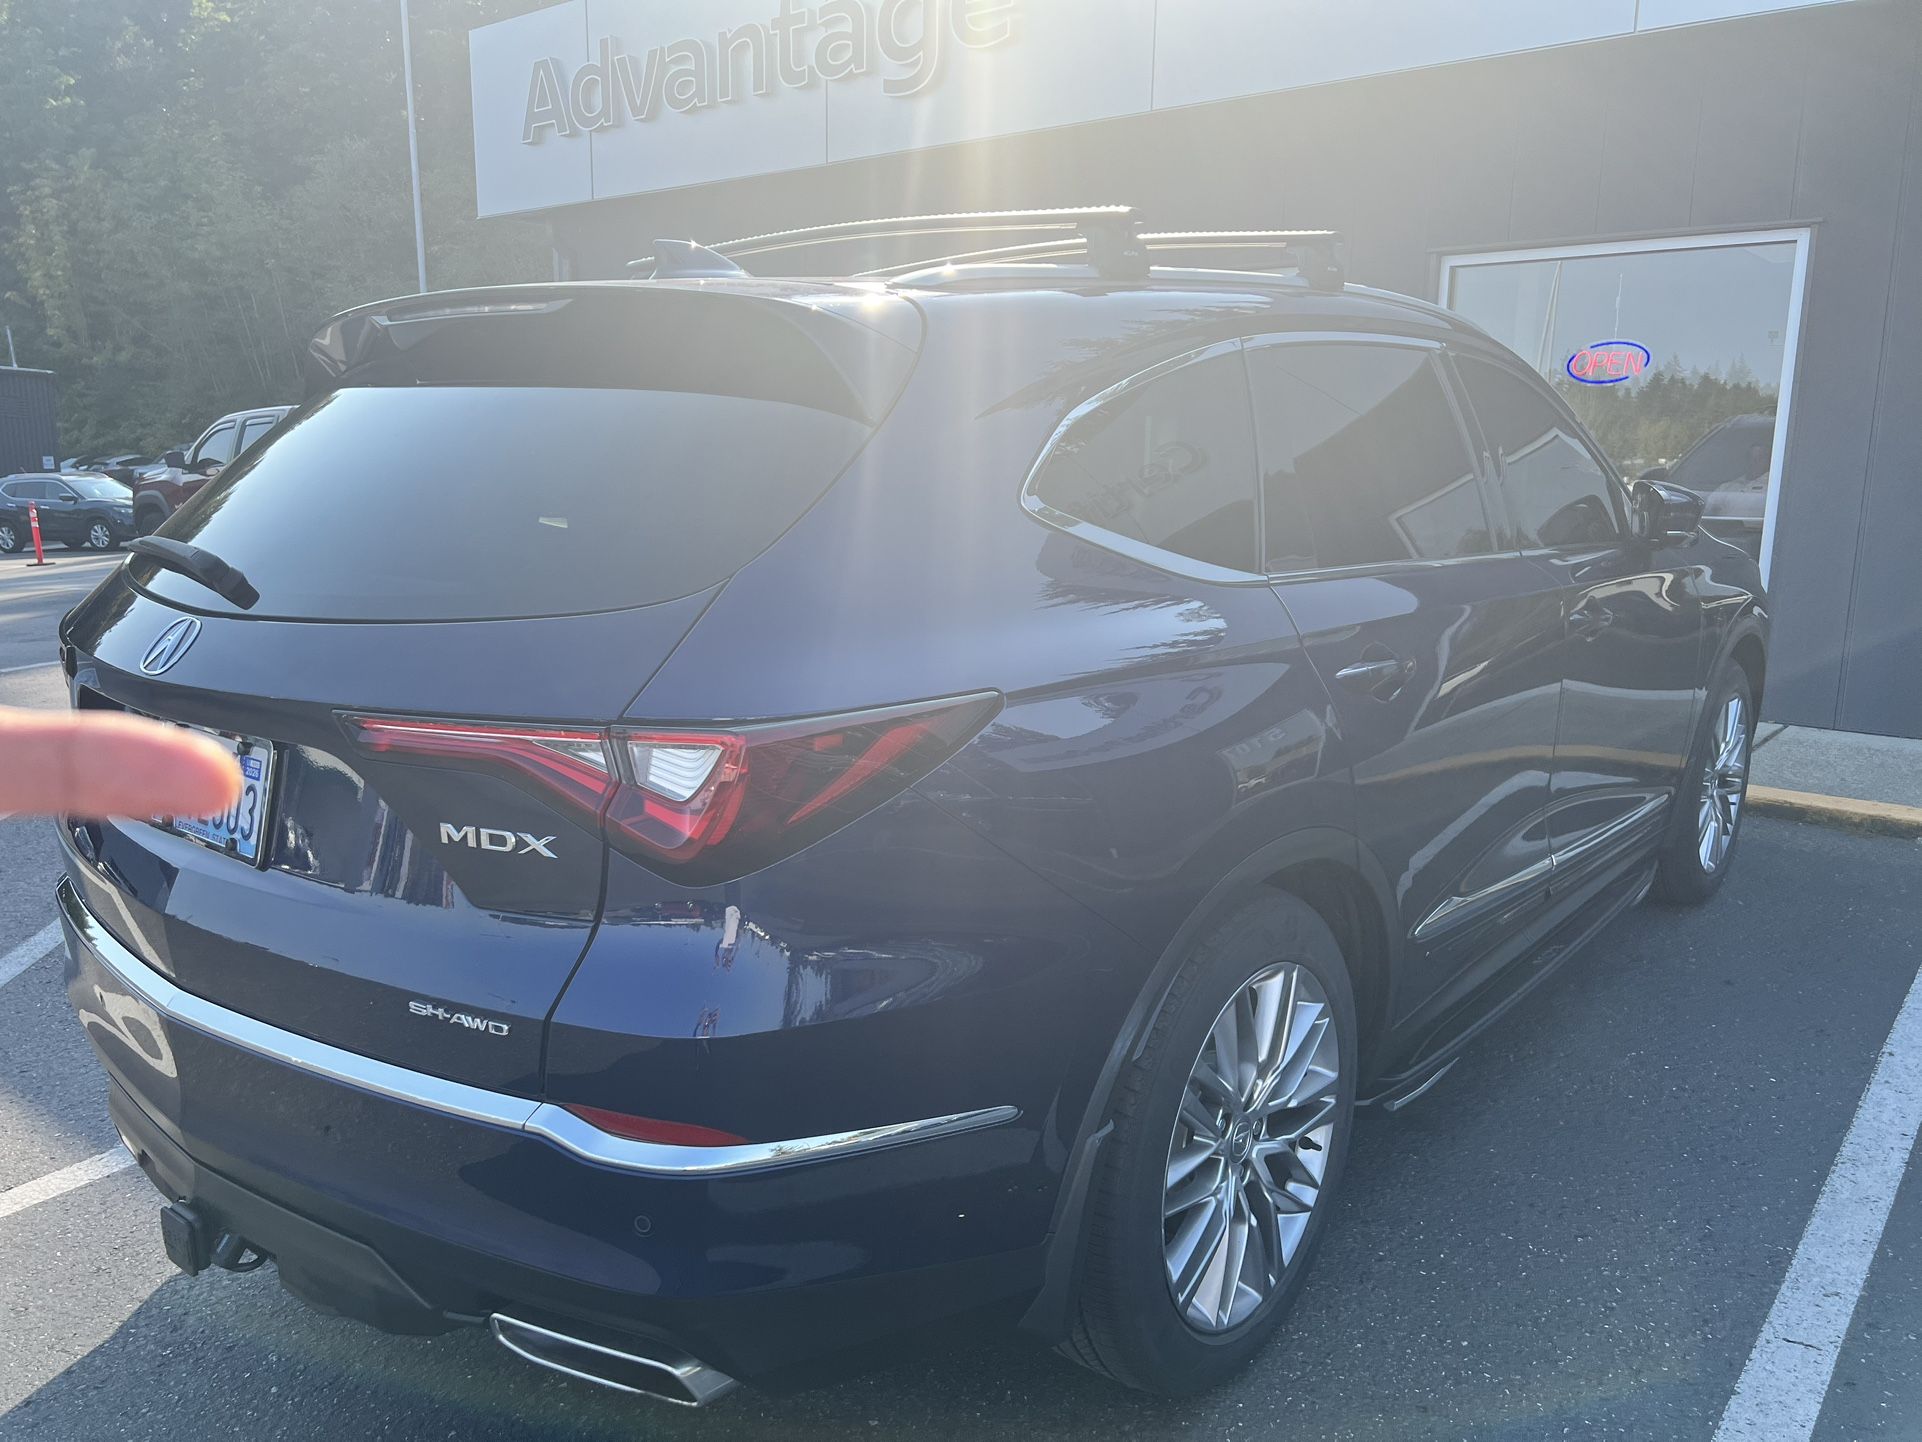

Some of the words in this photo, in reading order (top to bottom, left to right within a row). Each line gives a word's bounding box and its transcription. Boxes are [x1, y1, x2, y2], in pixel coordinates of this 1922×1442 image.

[521, 0, 1014, 144] Advantage
[1572, 350, 1644, 376] OPEN
[439, 822, 559, 859] MDX
[408, 1000, 512, 1036] SH-AWD
